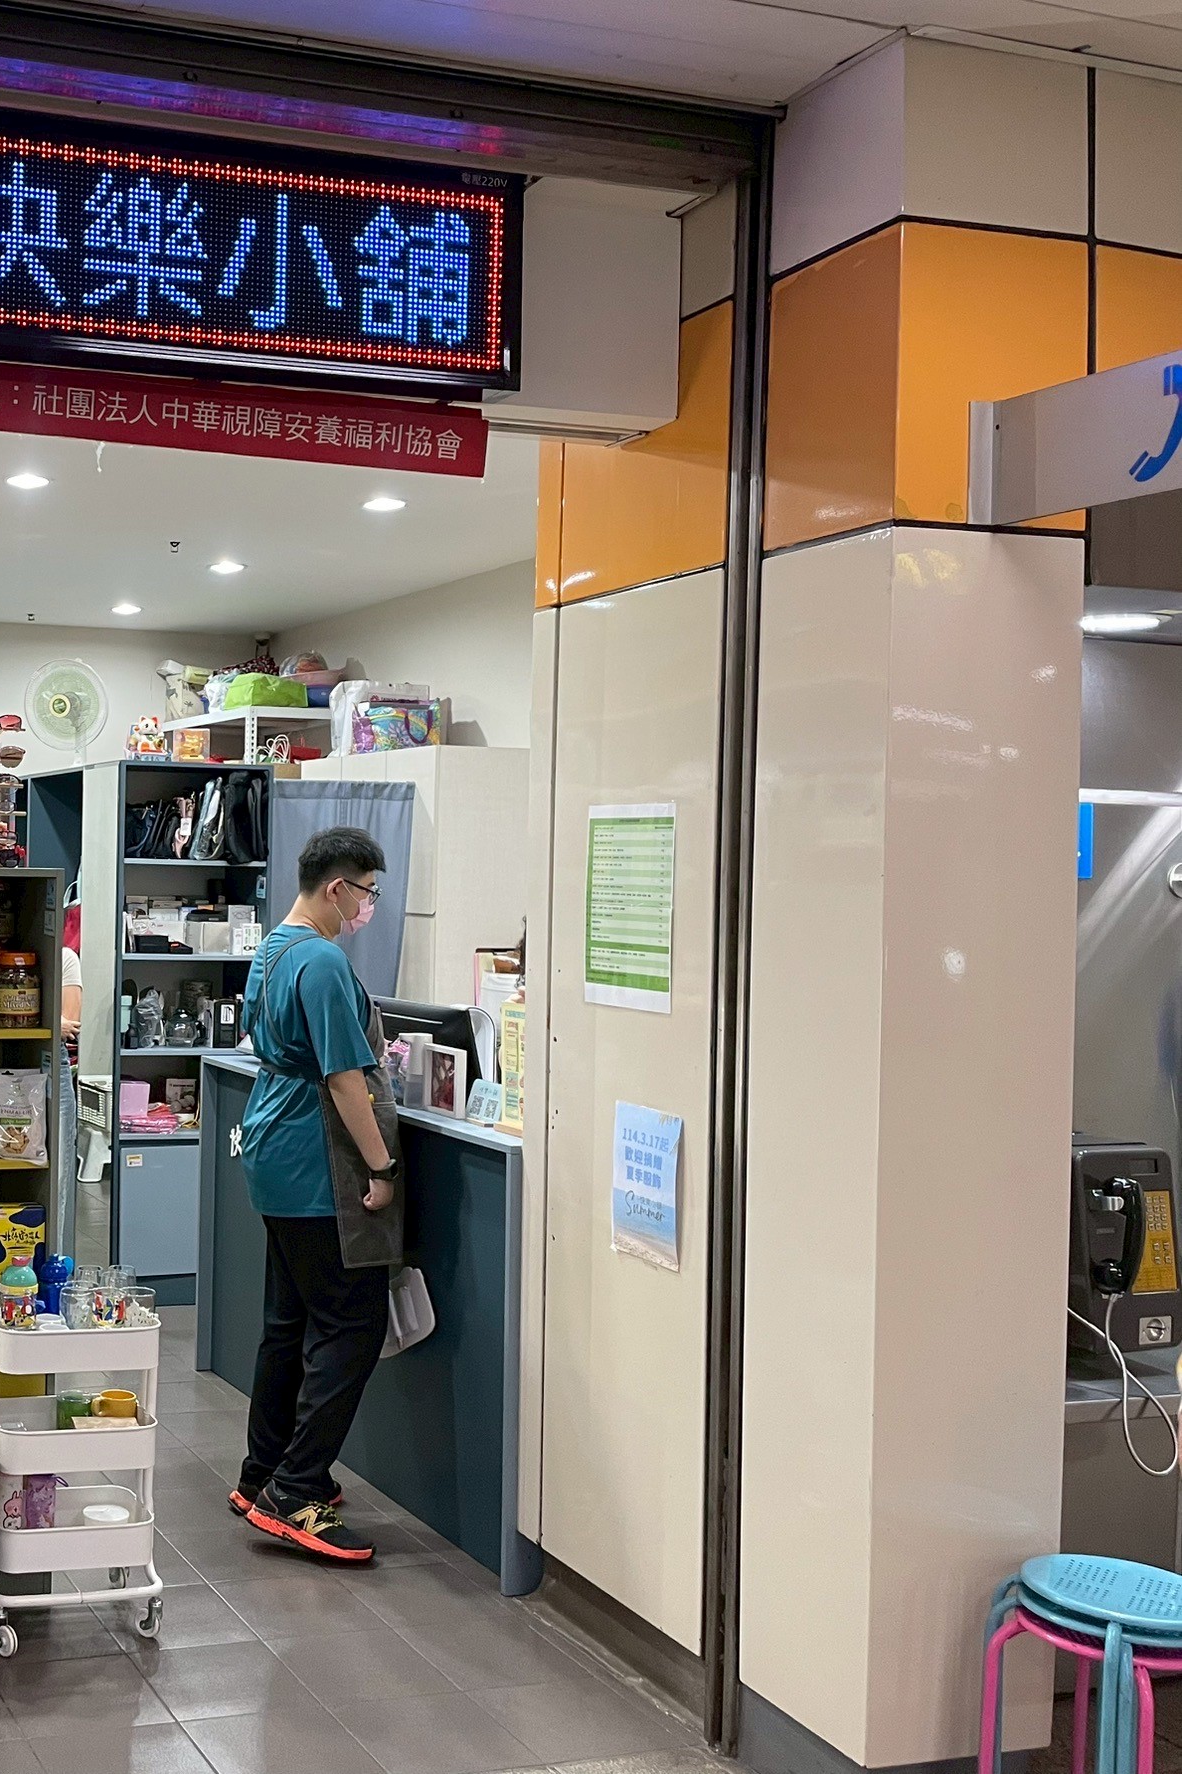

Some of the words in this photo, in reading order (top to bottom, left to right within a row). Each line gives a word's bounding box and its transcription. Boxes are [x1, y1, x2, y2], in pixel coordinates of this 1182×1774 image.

[622, 1127, 670, 1154] 114.3.17起
[626, 1165, 662, 1190] 夏季服飾
[625, 1190, 666, 1222] Summer
